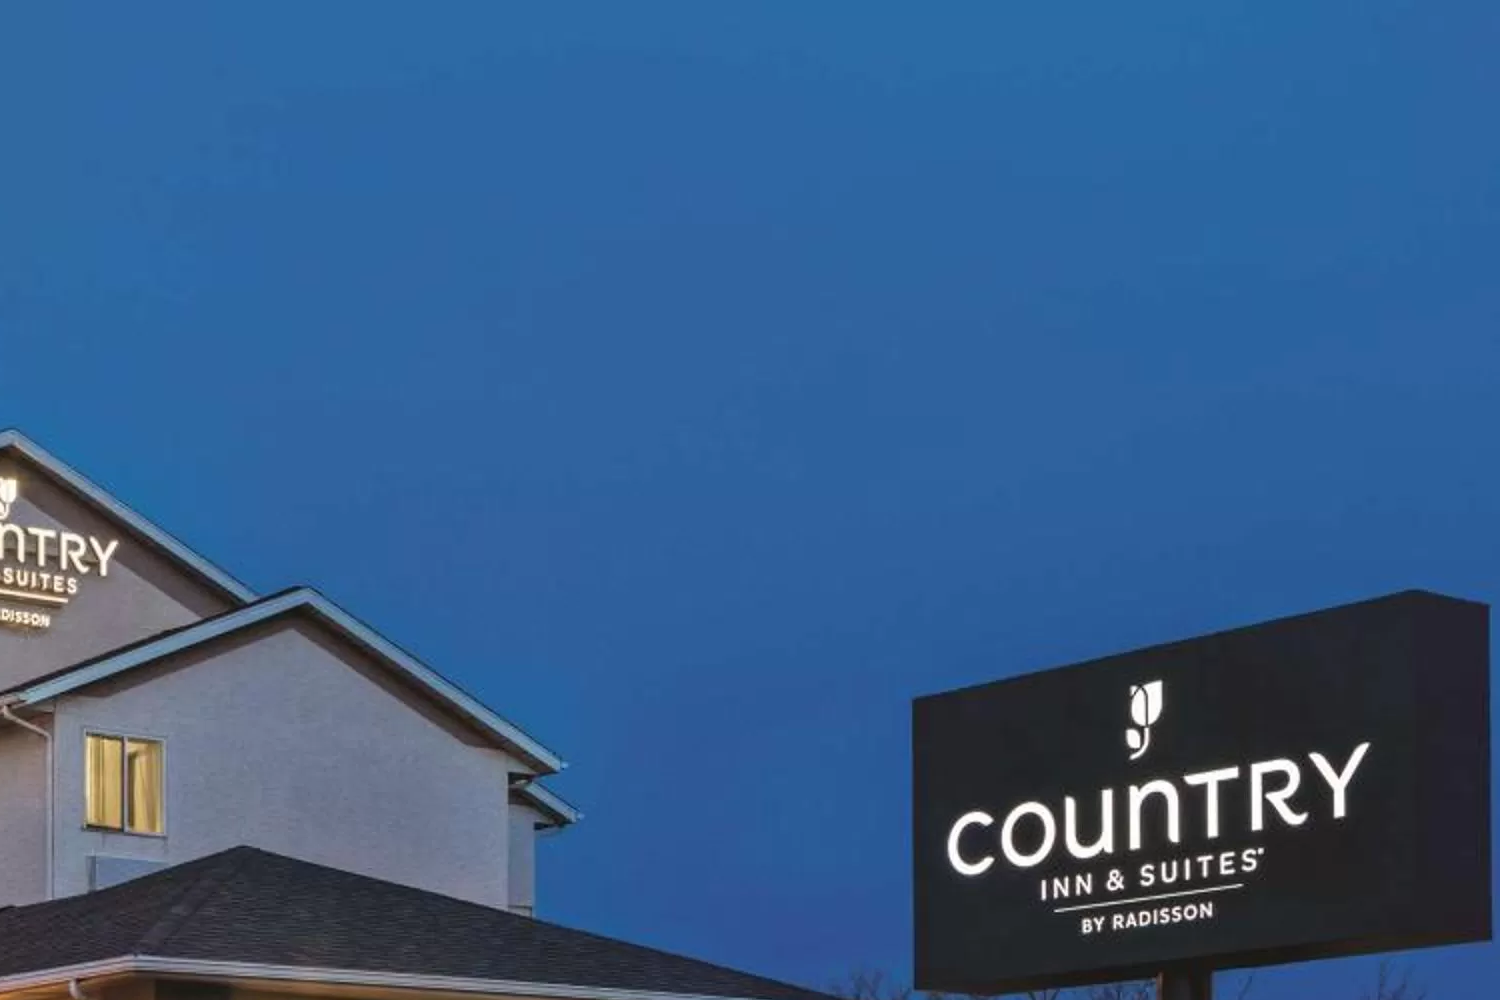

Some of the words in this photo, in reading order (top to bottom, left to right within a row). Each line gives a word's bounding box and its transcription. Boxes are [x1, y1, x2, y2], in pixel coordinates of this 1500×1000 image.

[3, 567, 78, 594] SUITES
[1040, 872, 1093, 901] INN
[1106, 869, 1125, 891] &
[1081, 916, 1105, 934] BY
[1112, 902, 1214, 930] RADISSON
